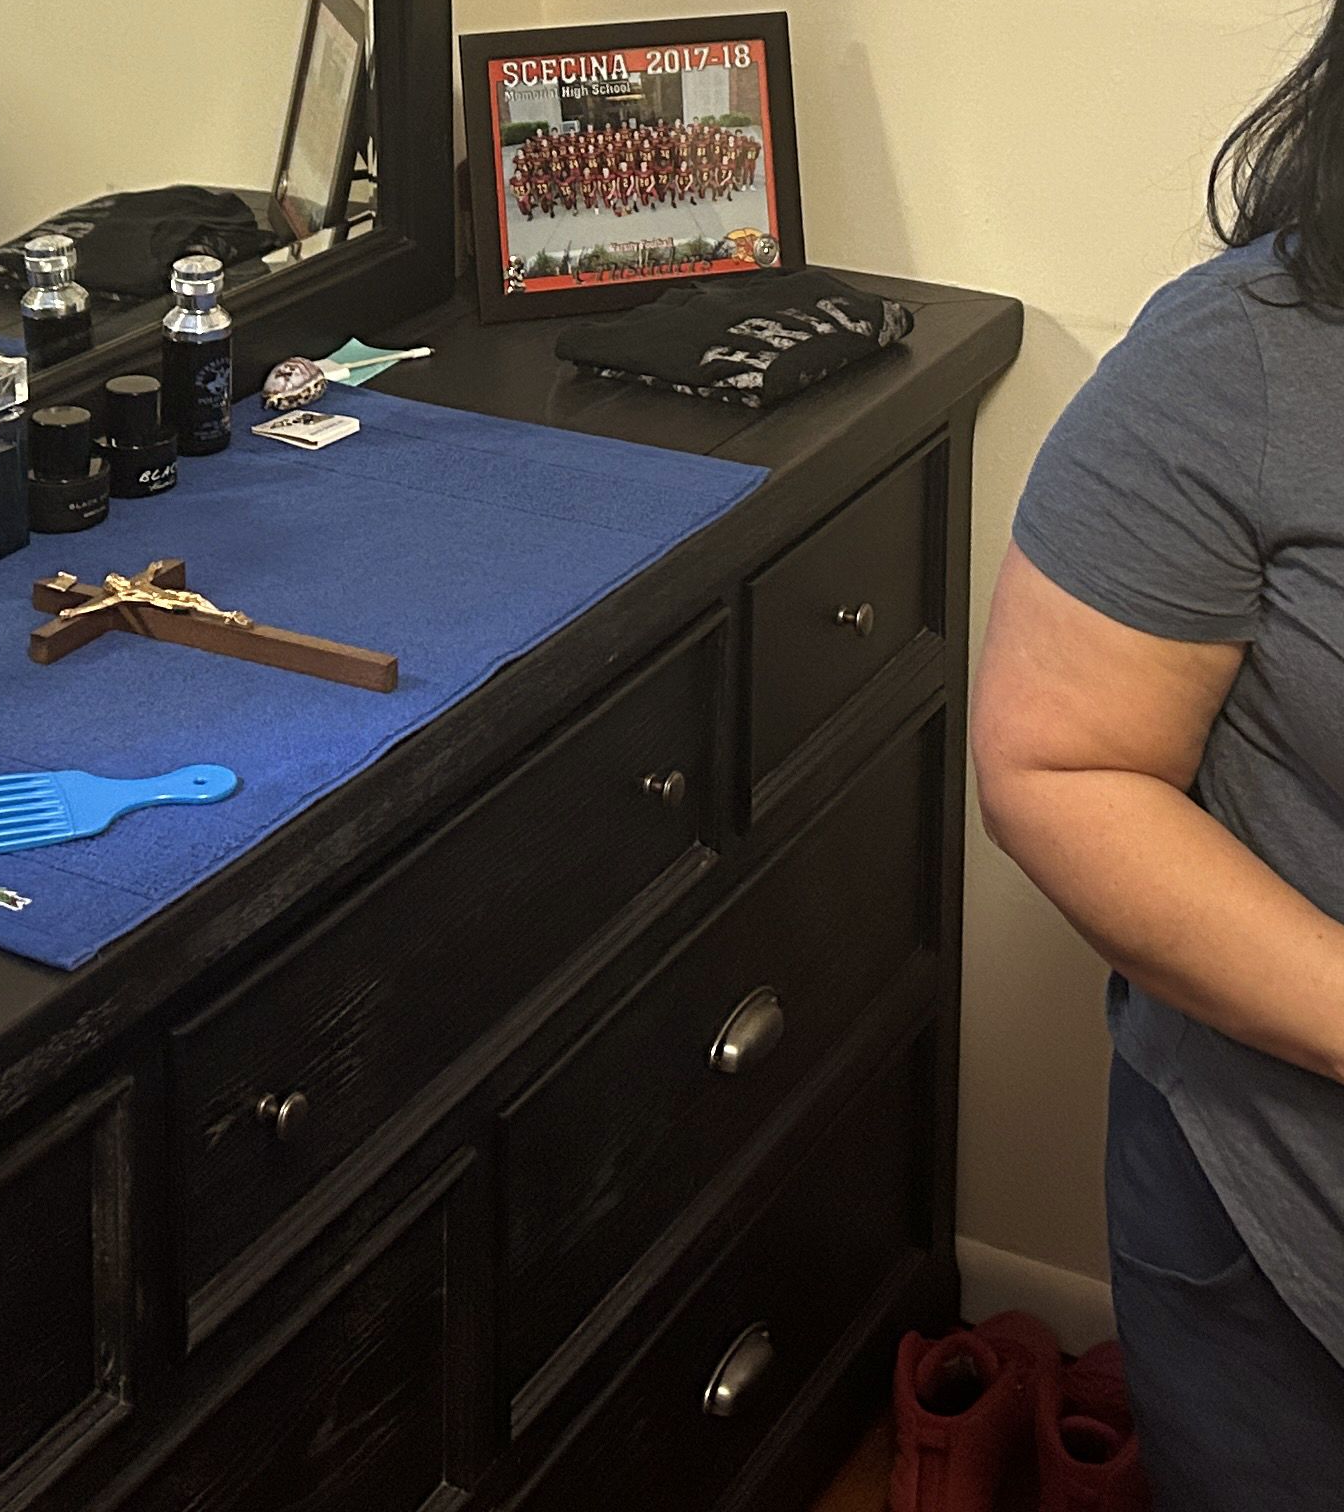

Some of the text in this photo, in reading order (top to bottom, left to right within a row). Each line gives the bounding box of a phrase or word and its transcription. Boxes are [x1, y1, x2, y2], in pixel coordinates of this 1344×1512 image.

[502, 43, 751, 88] SCECINA 2017-18
[562, 85, 589, 99] High
[592, 82, 631, 96] School
